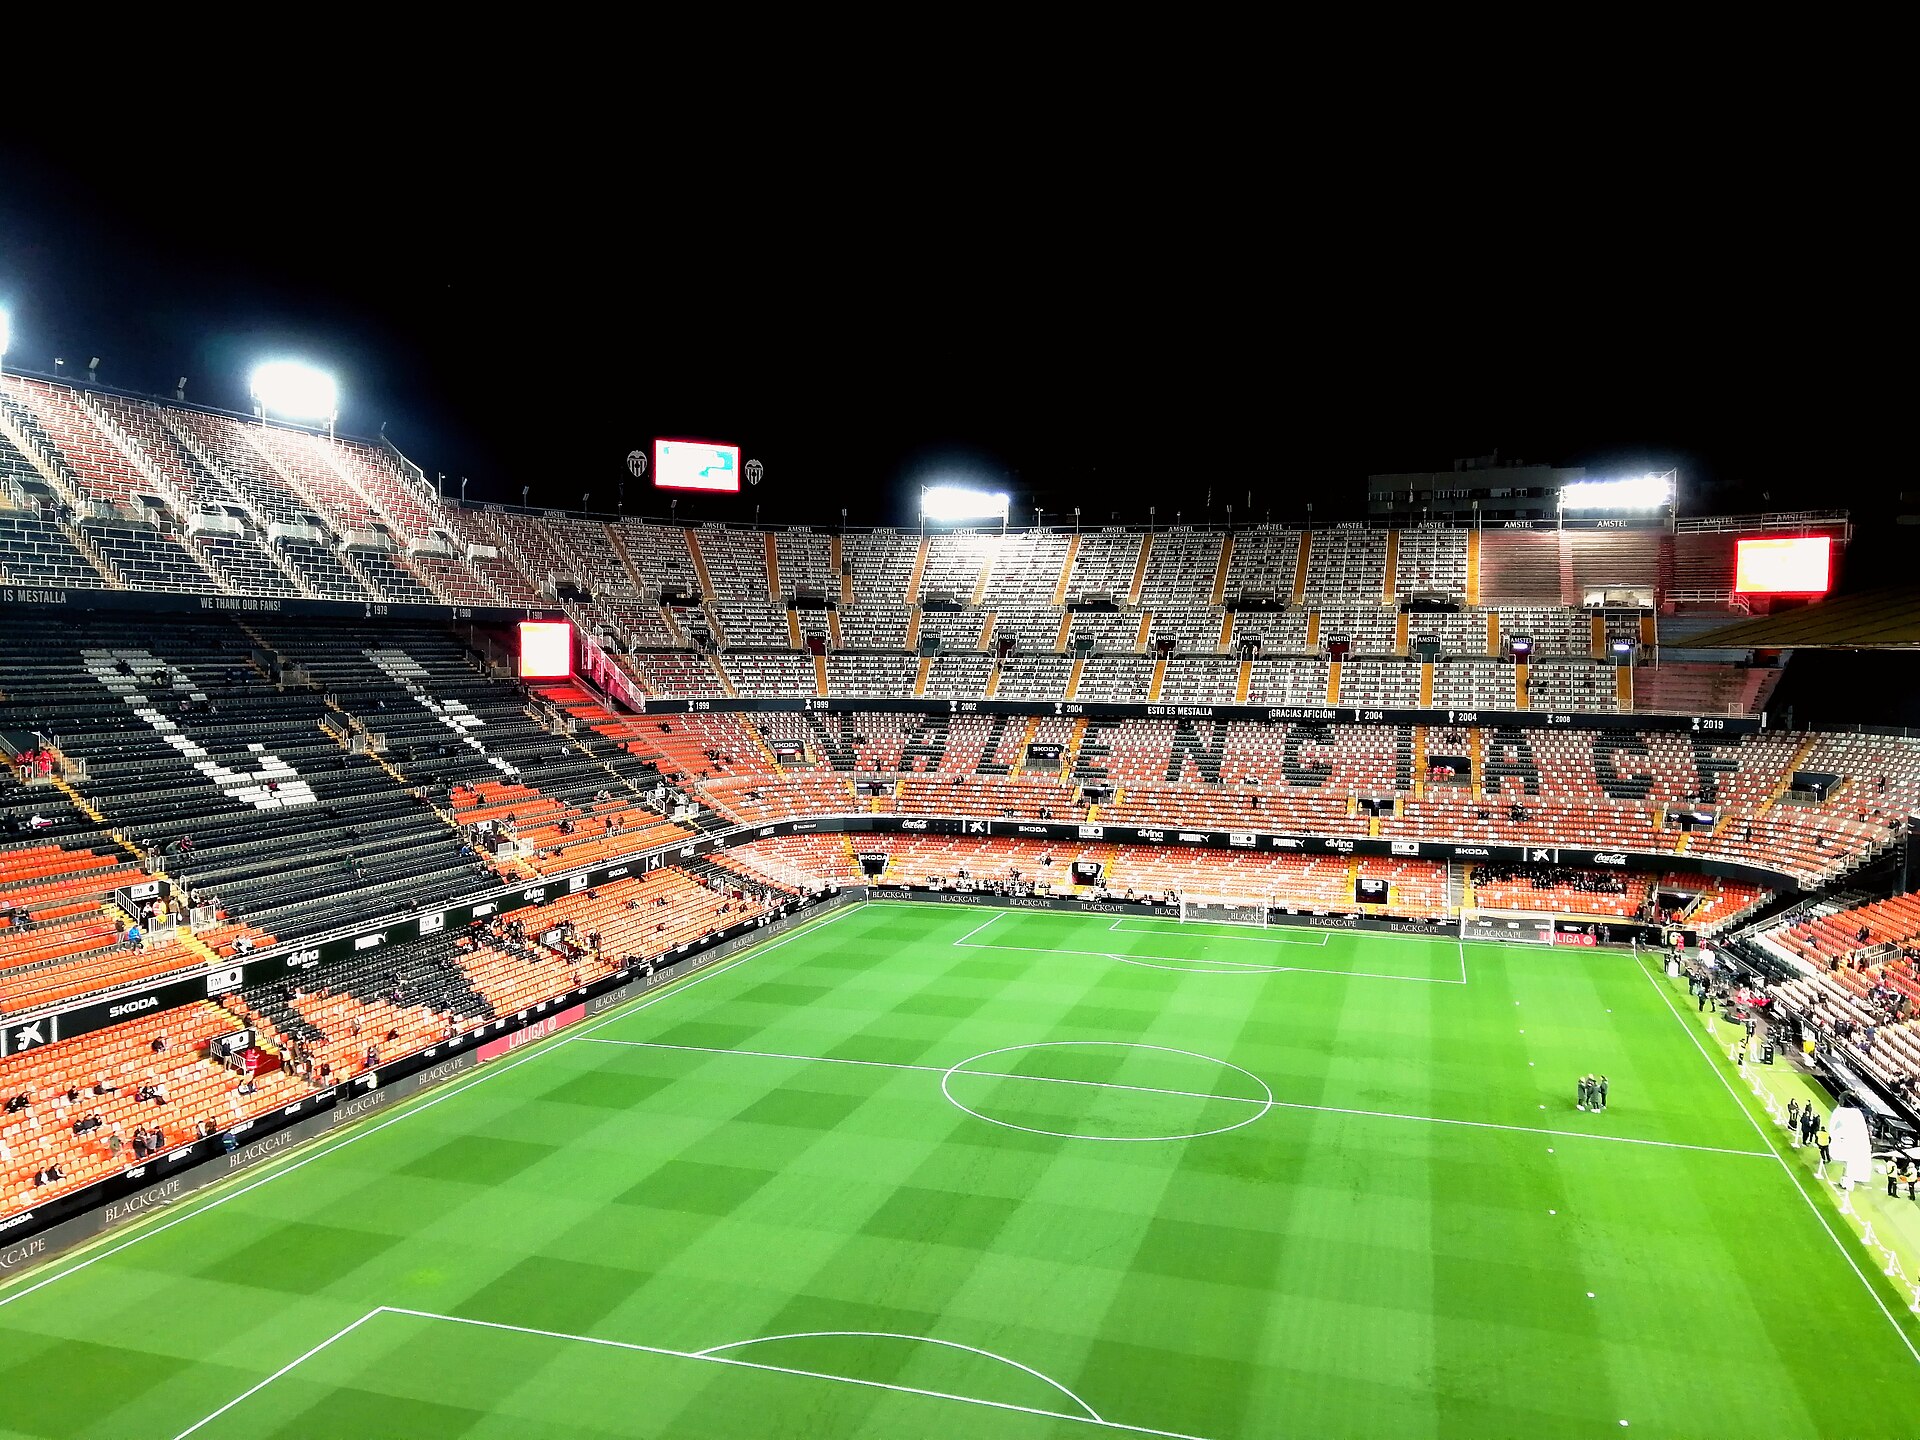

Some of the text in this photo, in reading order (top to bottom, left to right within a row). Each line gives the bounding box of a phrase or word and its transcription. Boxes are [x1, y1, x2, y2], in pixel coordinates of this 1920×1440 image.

[620, 516, 643, 524] AMSTEL
[3, 589, 67, 603] IS MESTALLA
[200, 597, 281, 611] WE THANK OUR FANS!
[374, 604, 388, 615] 1979
[695, 701, 710, 710] 1999
[813, 700, 829, 709] 1999
[961, 702, 978, 711] 2002
[1066, 704, 1083, 713] 2004
[1147, 706, 1213, 716] ESTO ES MESTALLA
[1268, 708, 1336, 719] ¡GRACIAS AFICIÓN!
[1364, 711, 1383, 720] 2004
[1458, 712, 1477, 721] 2004
[1555, 715, 1571, 723] 2008
[1703, 719, 1724, 730] 2019
[1137, 829, 1164, 838] divina
[1325, 838, 1354, 849] divina
[523, 887, 545, 900] divina
[872, 890, 913, 900] BLACKCAPE
[940, 894, 981, 904] BLACKCAPE
[1009, 898, 1050, 908] BLACKCAPE
[1081, 903, 1124, 912] BLACKCAPE
[1154, 907, 1199, 917] BLACKAPE
[1309, 918, 1357, 928] BLACKCAPE
[1390, 924, 1439, 933] BLACKCAPE
[1473, 929, 1523, 939] BLACKCAPE
[287, 949, 319, 967] divina
[646, 968, 674, 986] BLACKCAPE
[595, 988, 627, 1009] BLACKCAPE
[109, 996, 159, 1018] SKODA
[509, 1023, 545, 1049] LALIGA
[419, 1057, 463, 1086] BLACKCAPE
[333, 1091, 385, 1123] BLACKCAPE
[229, 1130, 292, 1168] BLACKCAPE
[105, 1179, 180, 1223] BLACKCAPE
